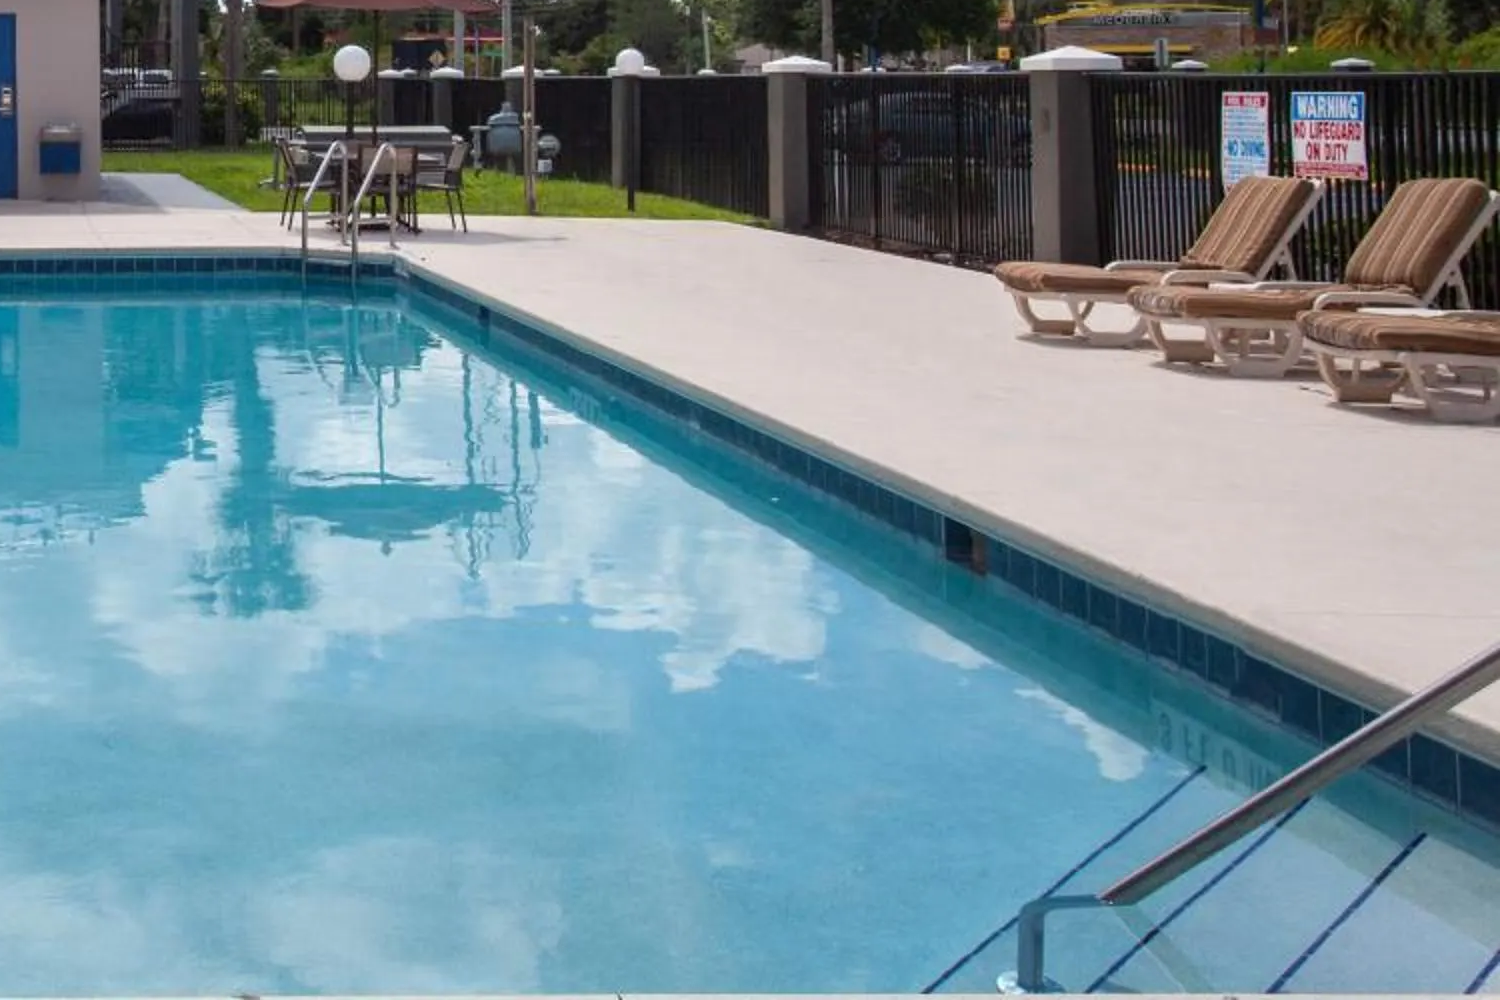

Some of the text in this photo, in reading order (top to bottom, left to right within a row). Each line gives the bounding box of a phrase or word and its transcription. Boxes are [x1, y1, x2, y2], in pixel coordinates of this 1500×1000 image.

[1297, 95, 1358, 118] WARNING
[1293, 121, 1361, 140] NO LIFEGUARD
[1306, 141, 1349, 161] ON DUTY
